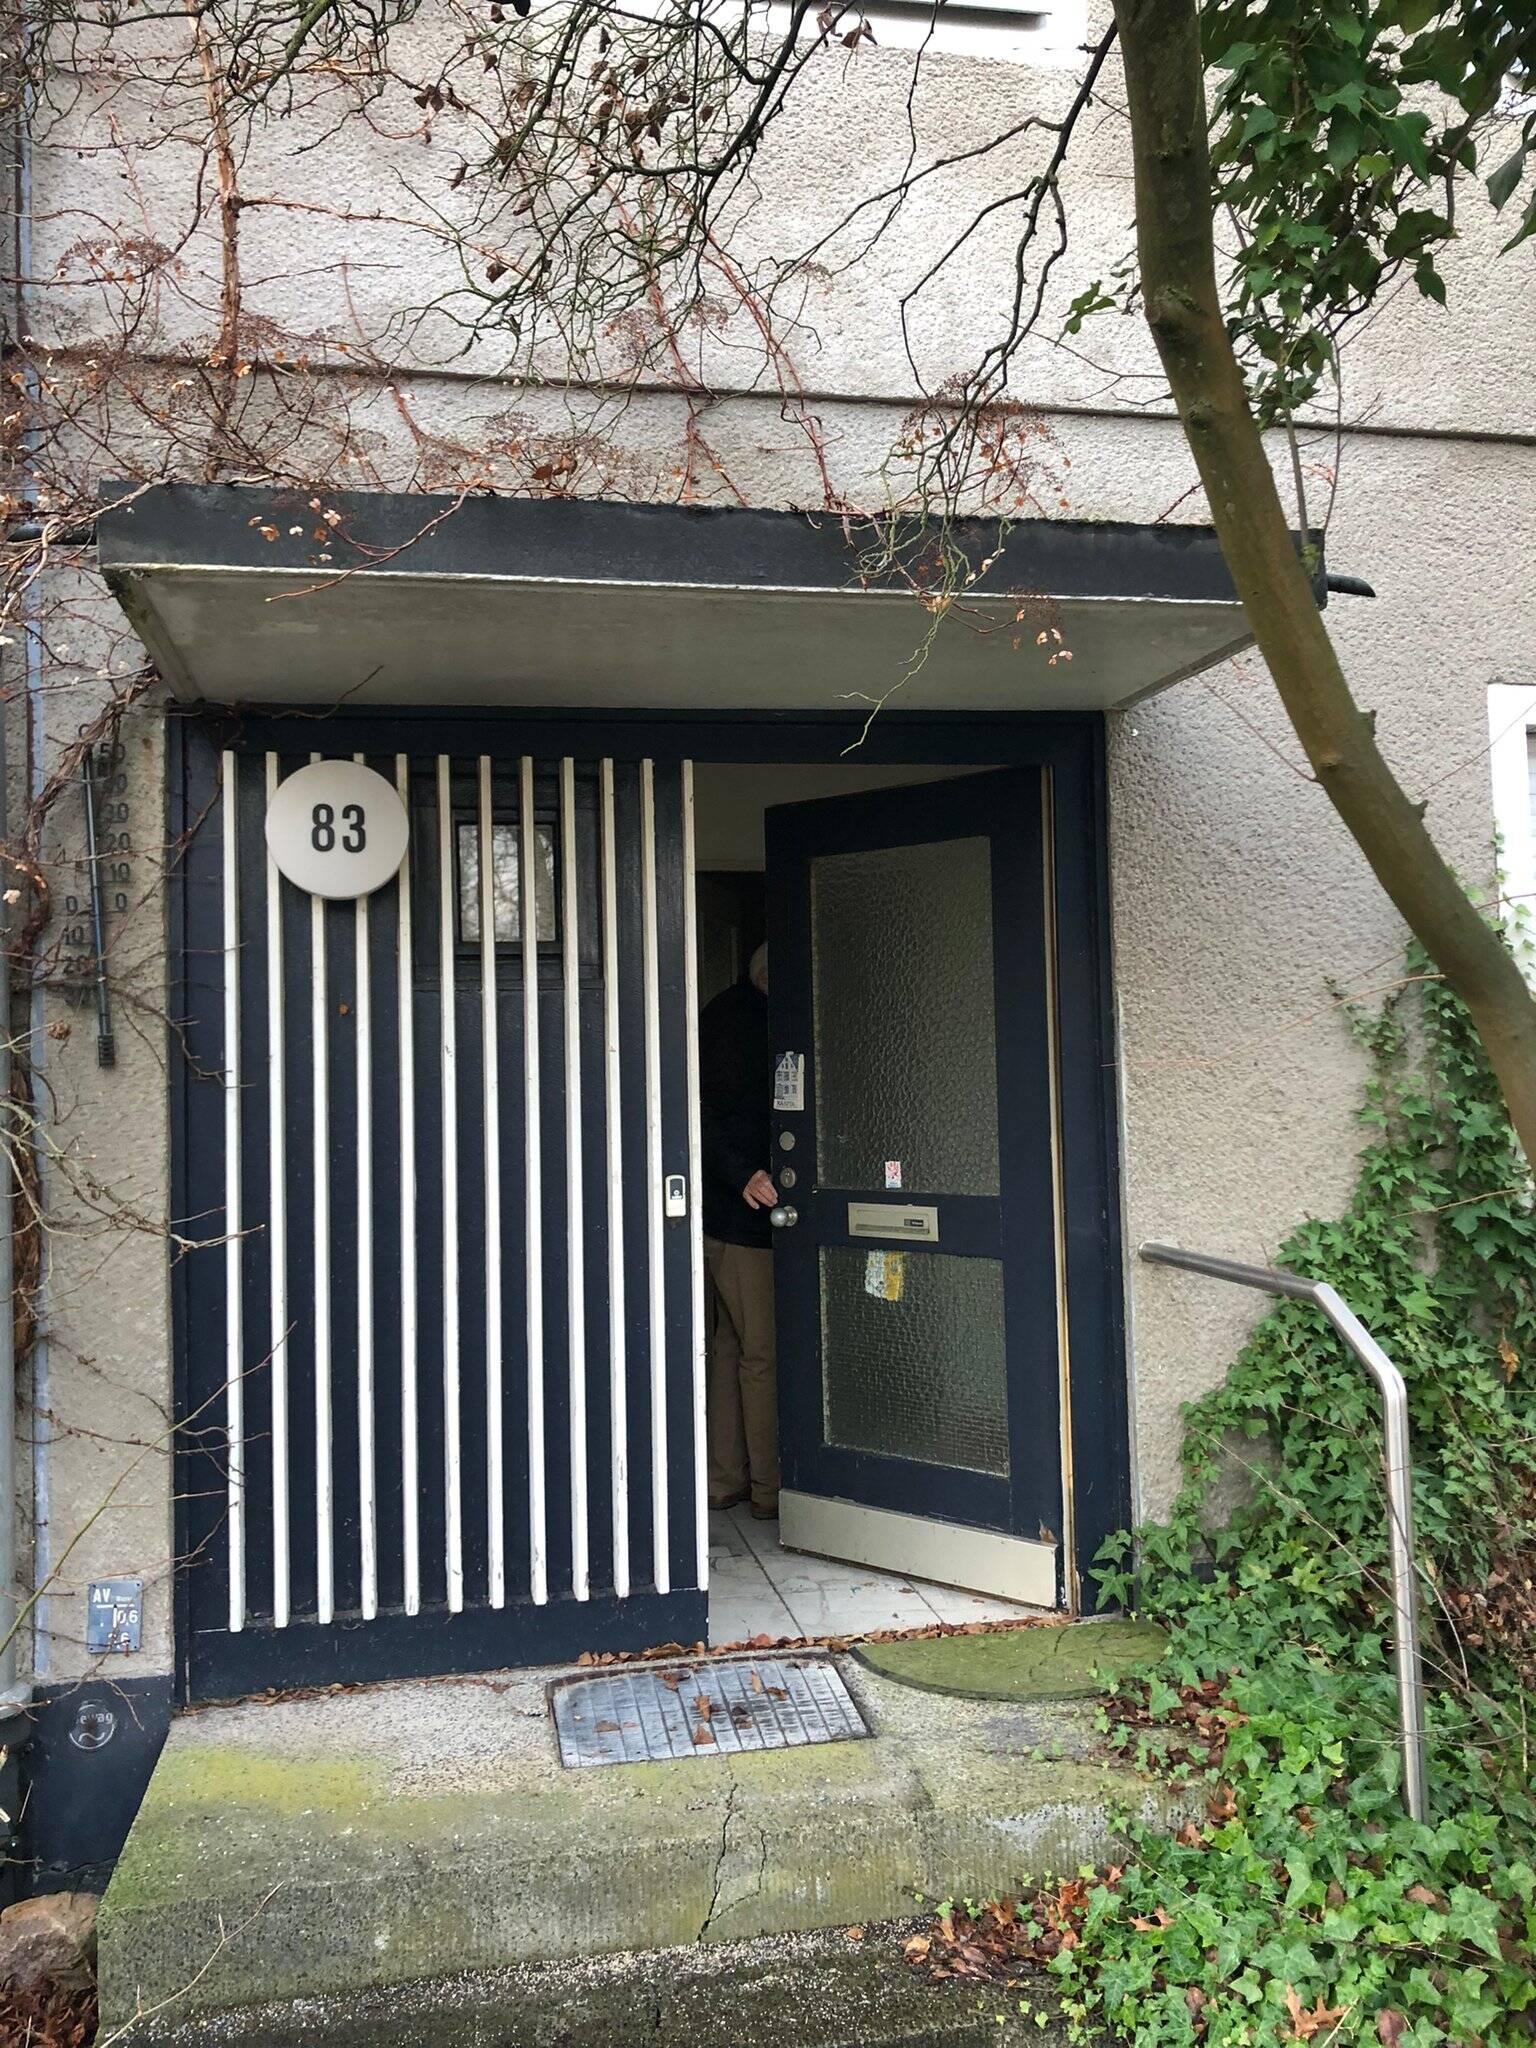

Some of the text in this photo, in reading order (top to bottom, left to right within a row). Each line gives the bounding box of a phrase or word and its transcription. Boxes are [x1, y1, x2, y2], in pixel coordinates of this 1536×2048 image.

[311, 803, 366, 853] 83
[110, 863, 130, 881] 10
[66, 895, 78, 913] 0
[115, 893, 127, 911] 0
[63, 925, 84, 945] 10
[93, 1588, 111, 1603] AV
